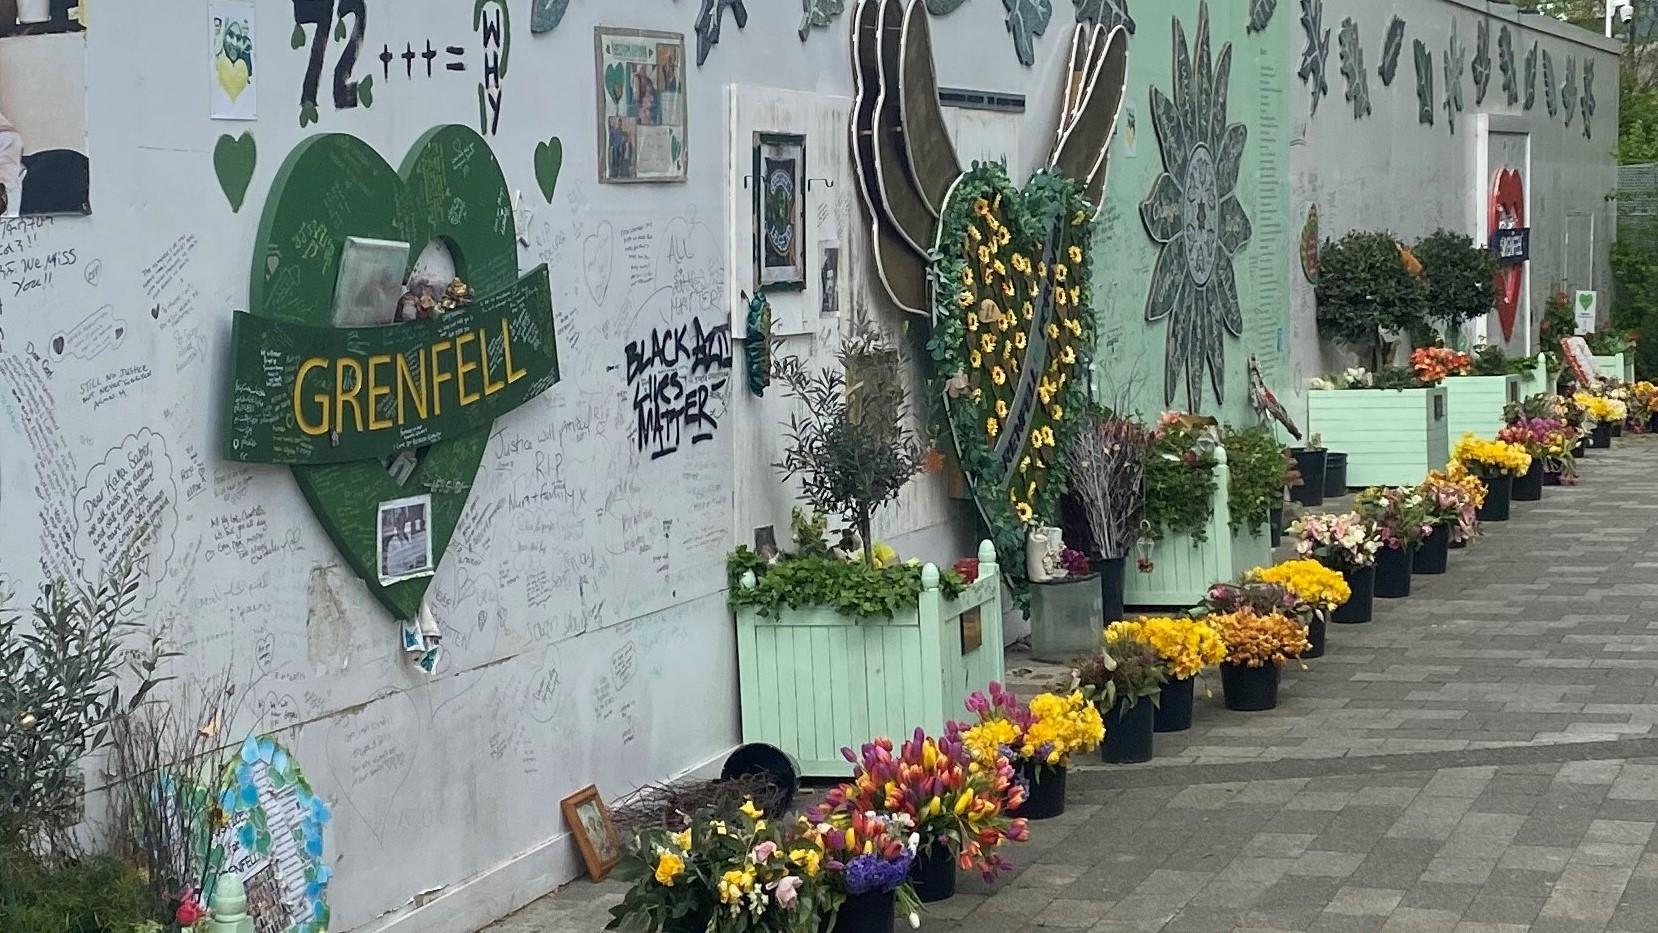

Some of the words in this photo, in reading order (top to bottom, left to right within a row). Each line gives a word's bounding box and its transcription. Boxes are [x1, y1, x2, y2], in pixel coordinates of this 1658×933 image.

[291, 0, 367, 110] 72
[484, 8, 502, 135] WHY
[79, 377, 104, 395] STILL
[293, 317, 527, 436] GRENFELL
[624, 323, 691, 386] BLACK
[637, 384, 719, 453] MATTER
[82, 488, 104, 523] Dear
[106, 492, 122, 511] miss
[121, 480, 133, 494] you
